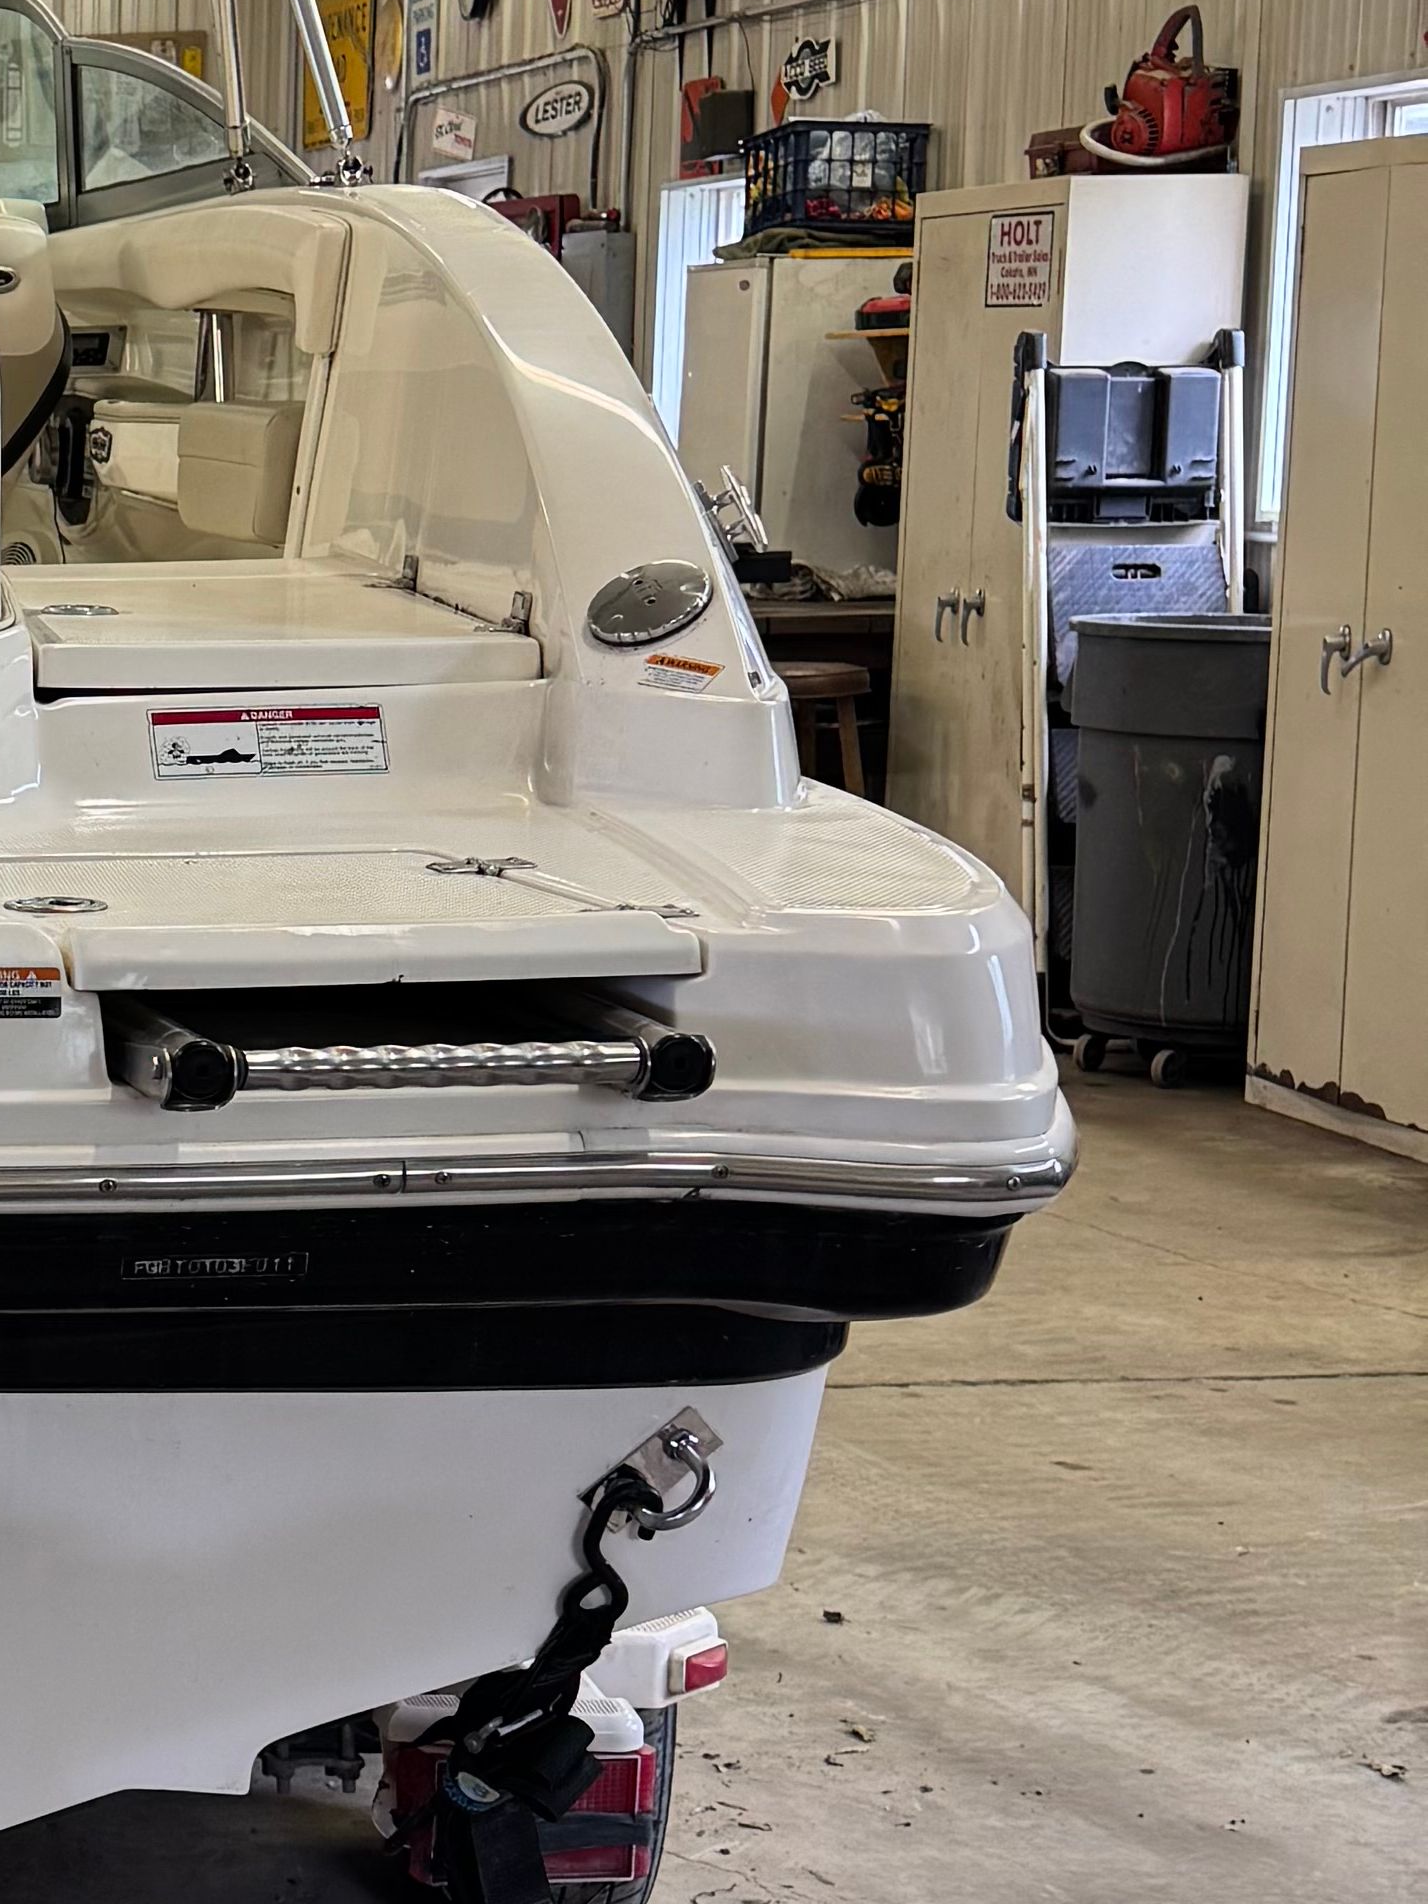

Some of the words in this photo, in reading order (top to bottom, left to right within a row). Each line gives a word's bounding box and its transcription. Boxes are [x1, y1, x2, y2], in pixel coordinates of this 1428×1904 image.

[534, 91, 582, 124] LESTER
[1000, 220, 1042, 247] HOLT
[250, 711, 293, 720] DANGER
